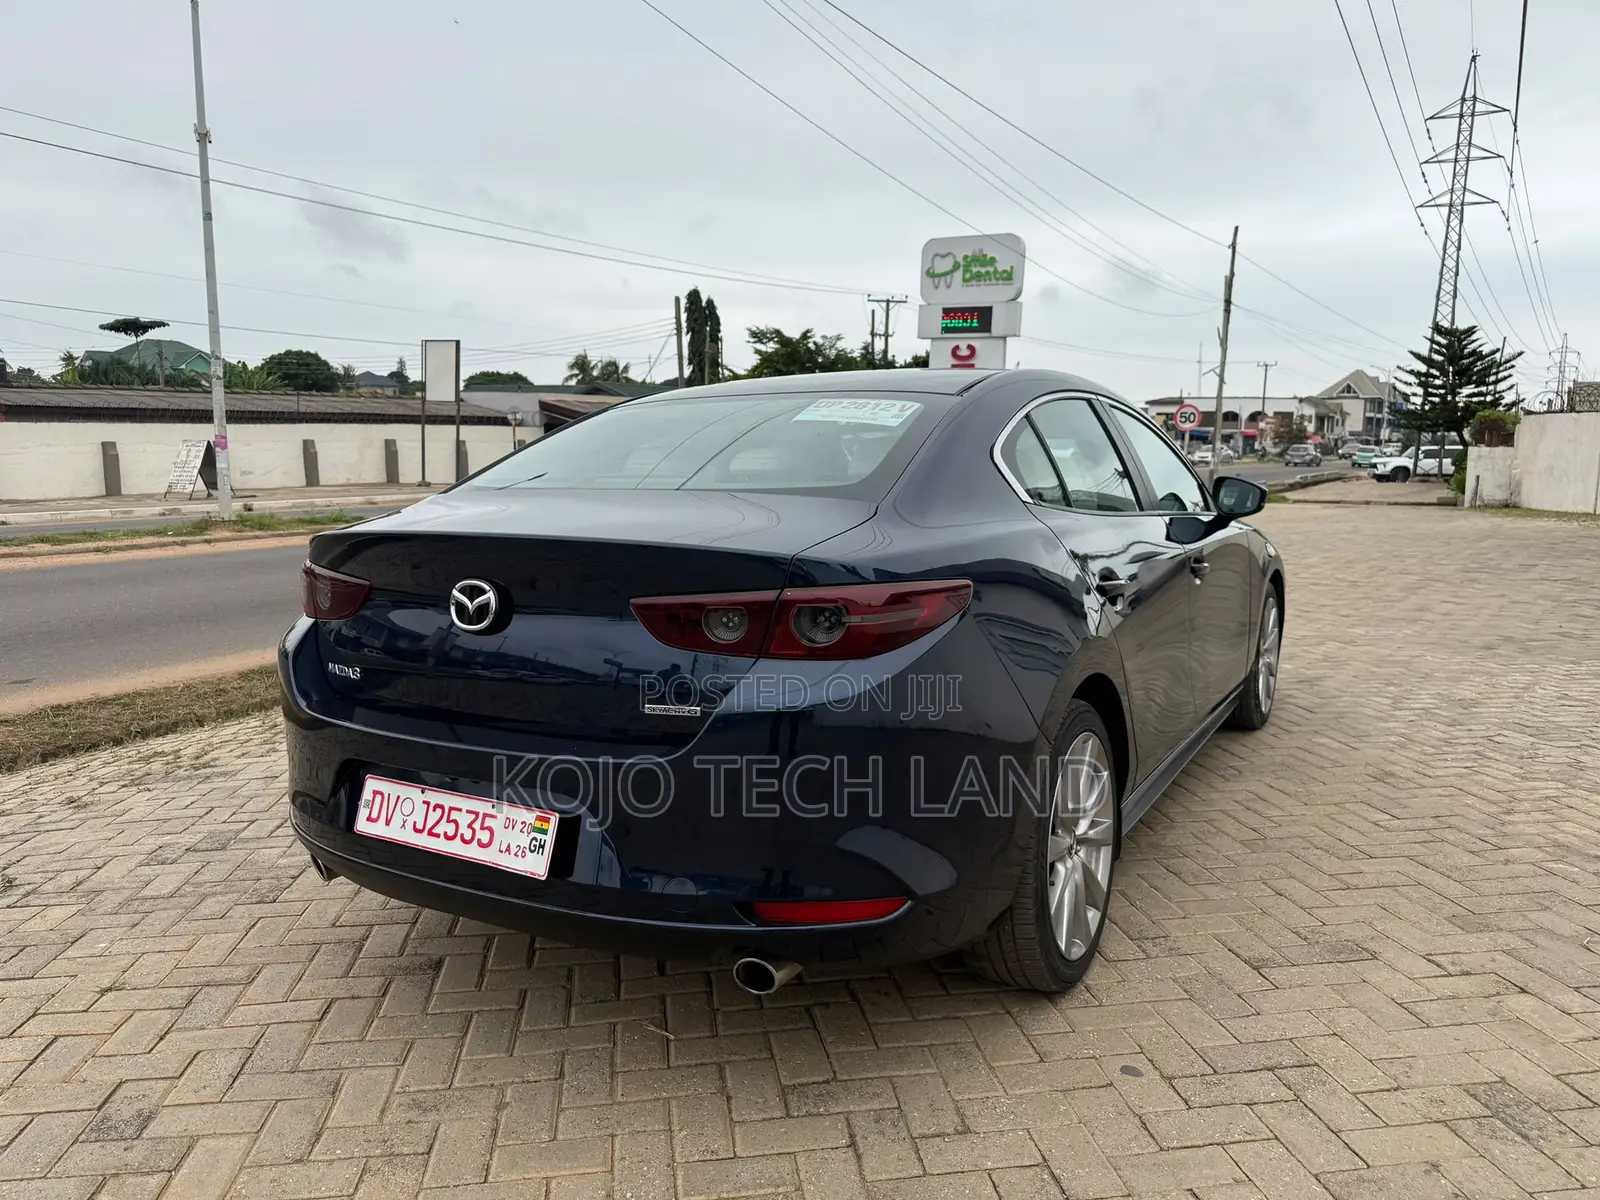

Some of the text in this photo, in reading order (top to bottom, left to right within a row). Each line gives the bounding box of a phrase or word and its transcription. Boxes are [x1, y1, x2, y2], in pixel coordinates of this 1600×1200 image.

[962, 265, 1014, 283] Dental
[1179, 411, 1197, 424] 50
[366, 789, 498, 849] DV J2535
[503, 816, 533, 835] DV 20
[498, 839, 527, 859] LA 26
[528, 836, 547, 856] GH
